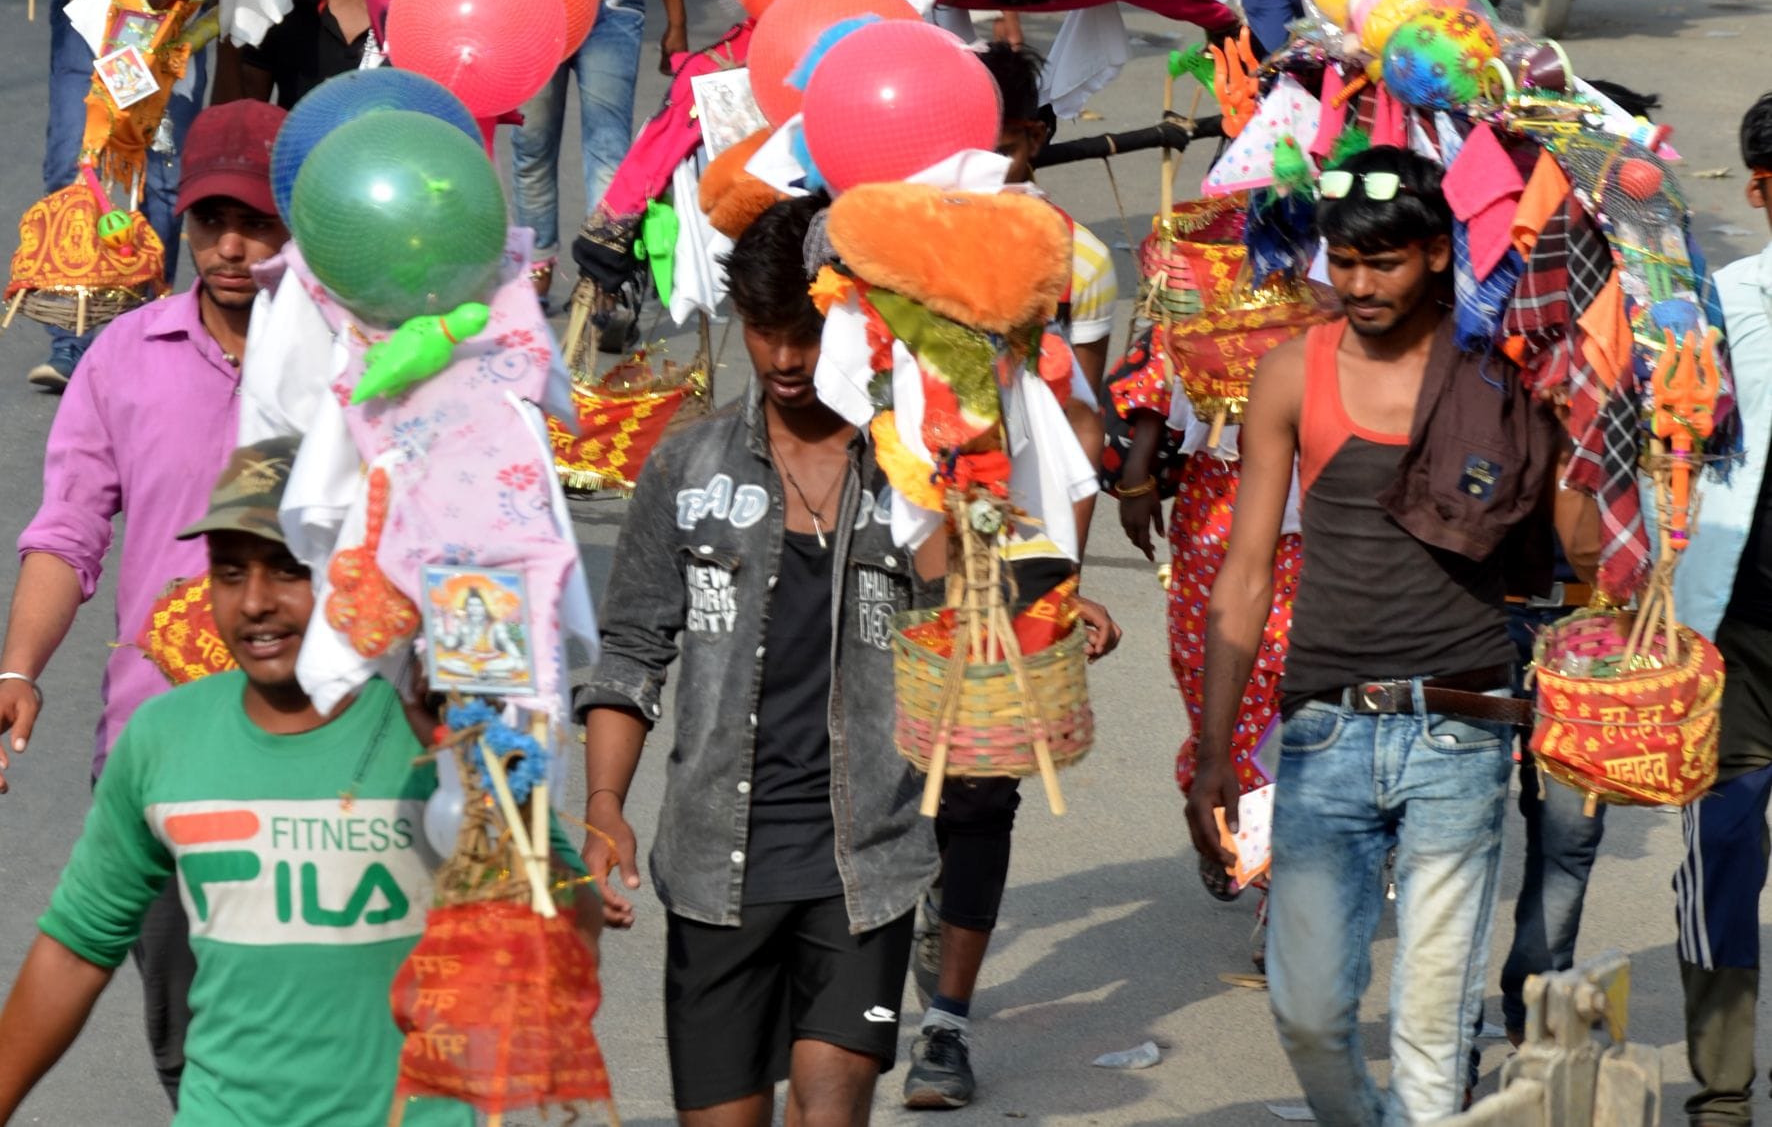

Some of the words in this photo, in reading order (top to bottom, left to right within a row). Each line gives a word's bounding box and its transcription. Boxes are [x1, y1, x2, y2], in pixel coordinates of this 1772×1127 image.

[687, 608, 738, 633] CITY
[271, 816, 414, 852] FITNESS
[164, 810, 409, 927] FILA
